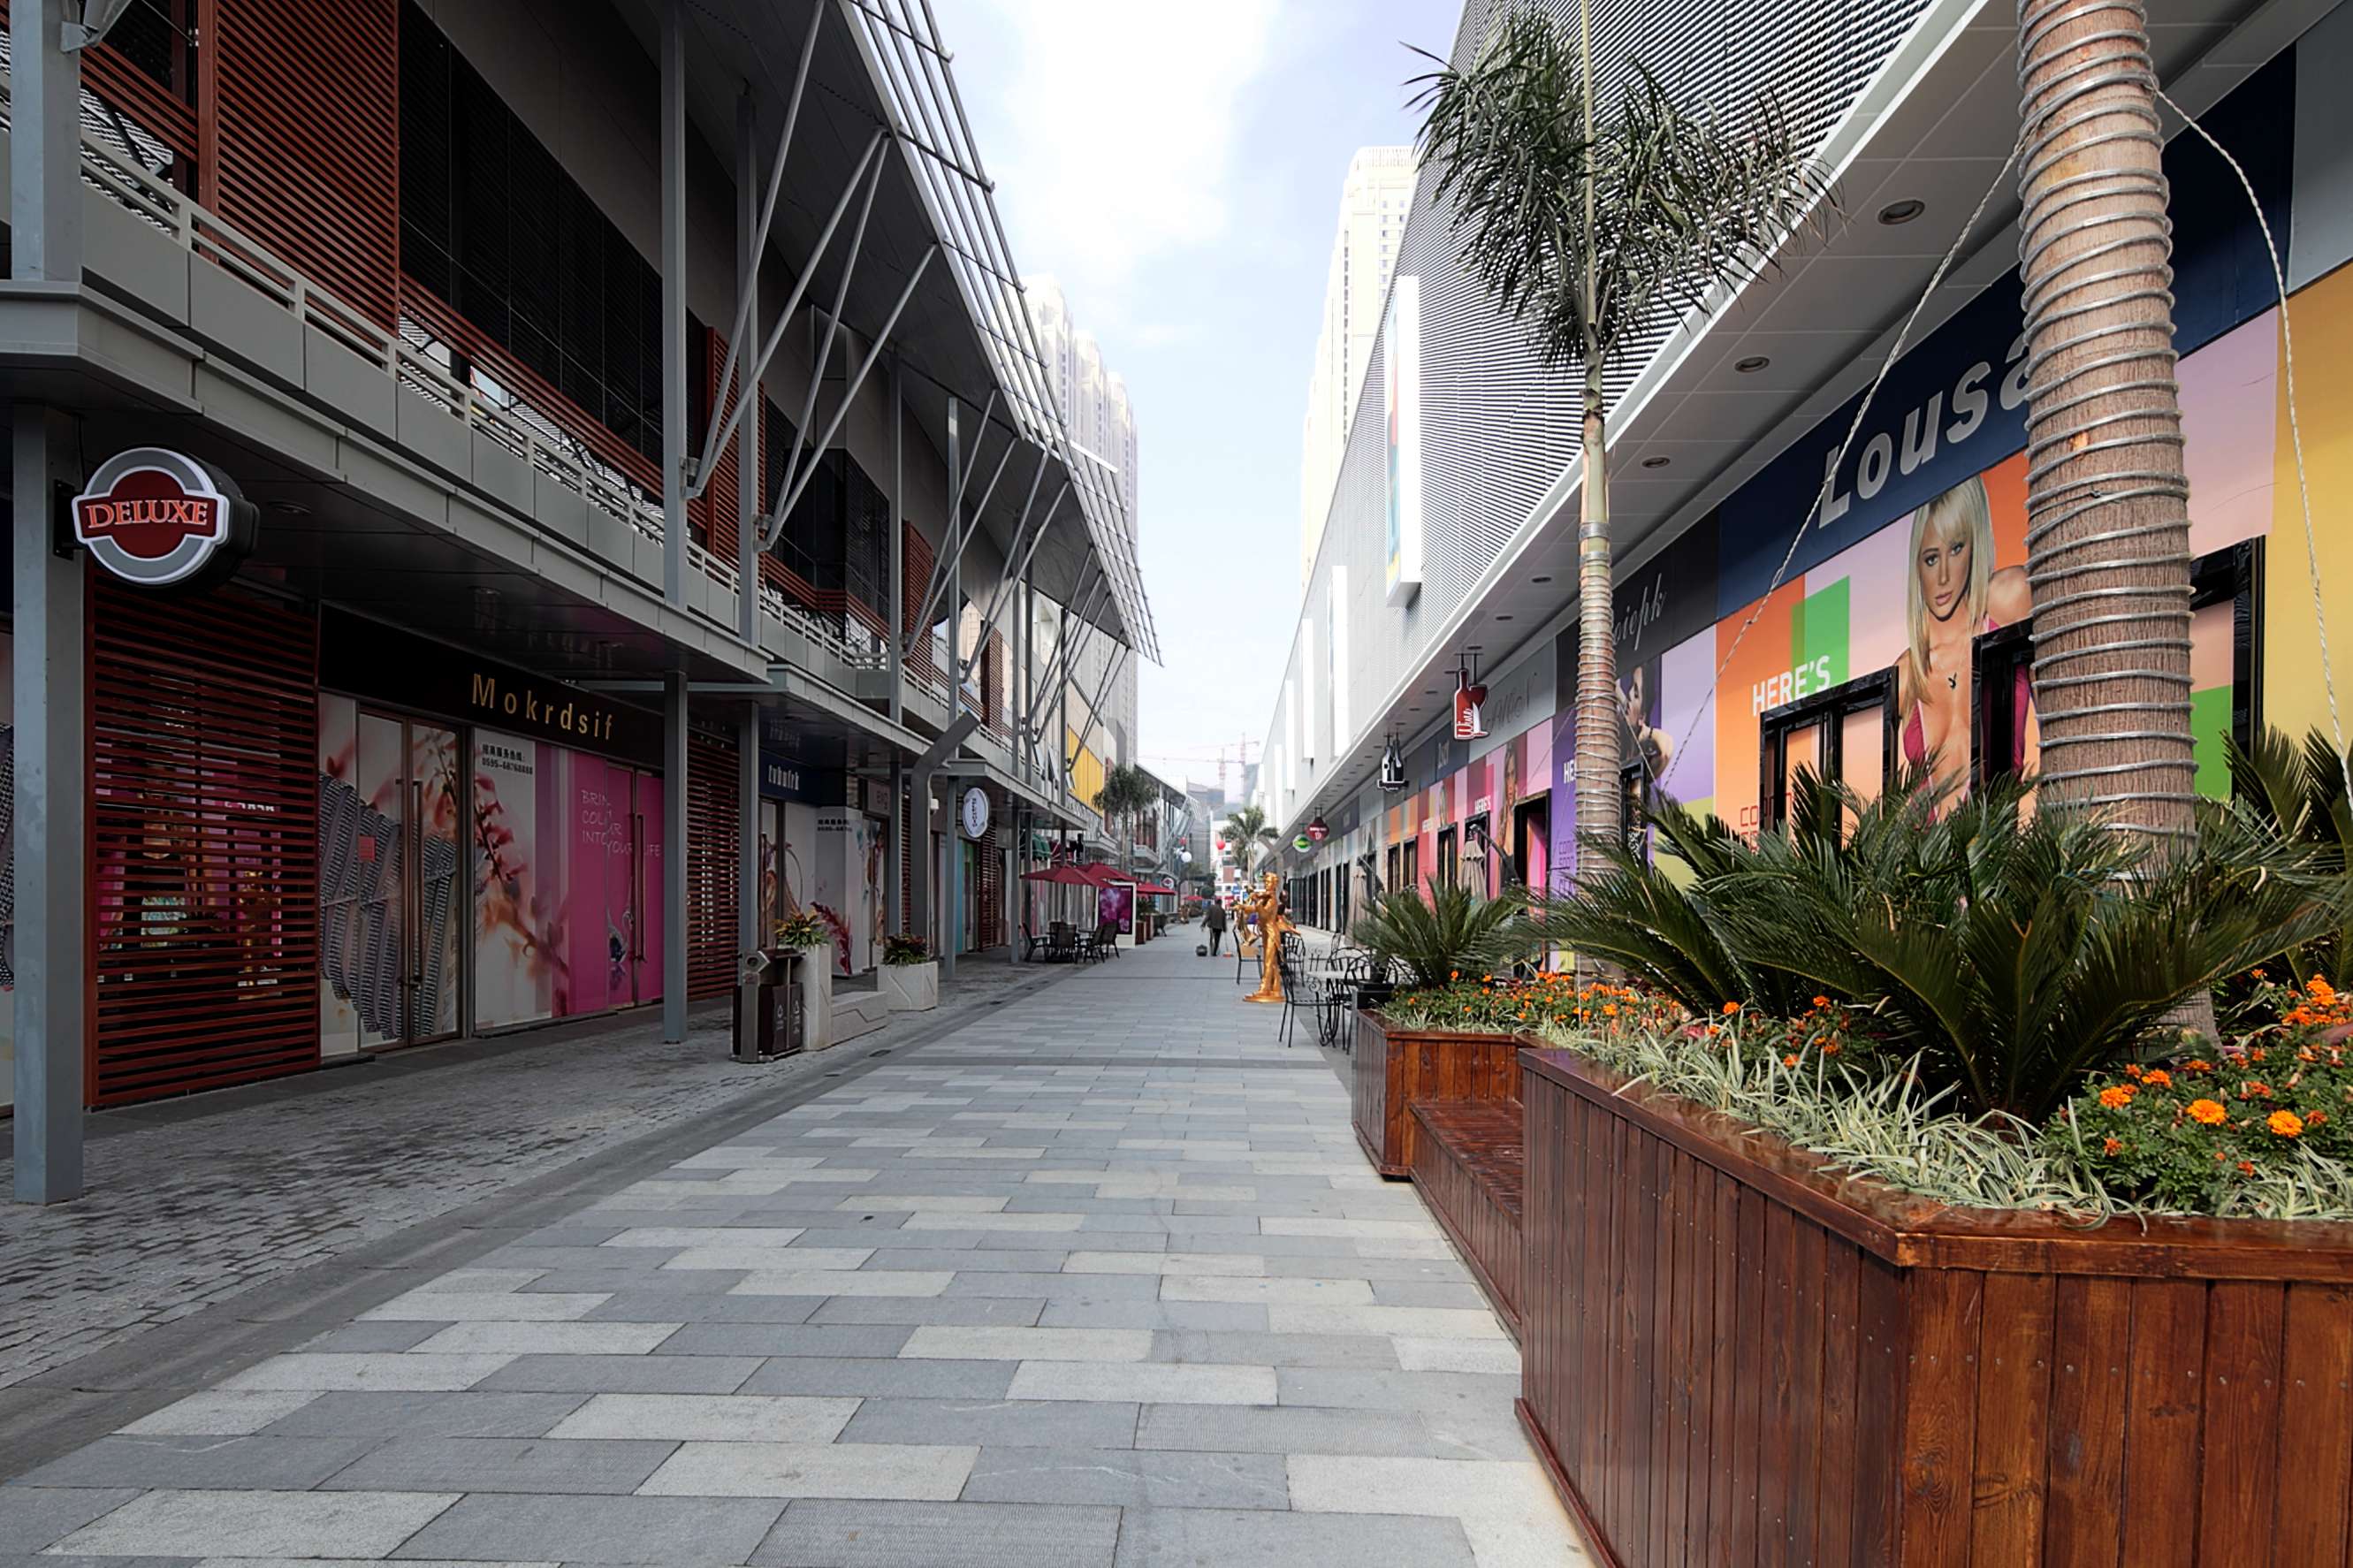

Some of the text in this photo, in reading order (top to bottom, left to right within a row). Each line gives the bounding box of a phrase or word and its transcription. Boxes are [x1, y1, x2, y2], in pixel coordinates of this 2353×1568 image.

[85, 499, 208, 529] DELUXE
[472, 673, 613, 741] Mokrdsif
[1753, 655, 1831, 717] HERE'S
